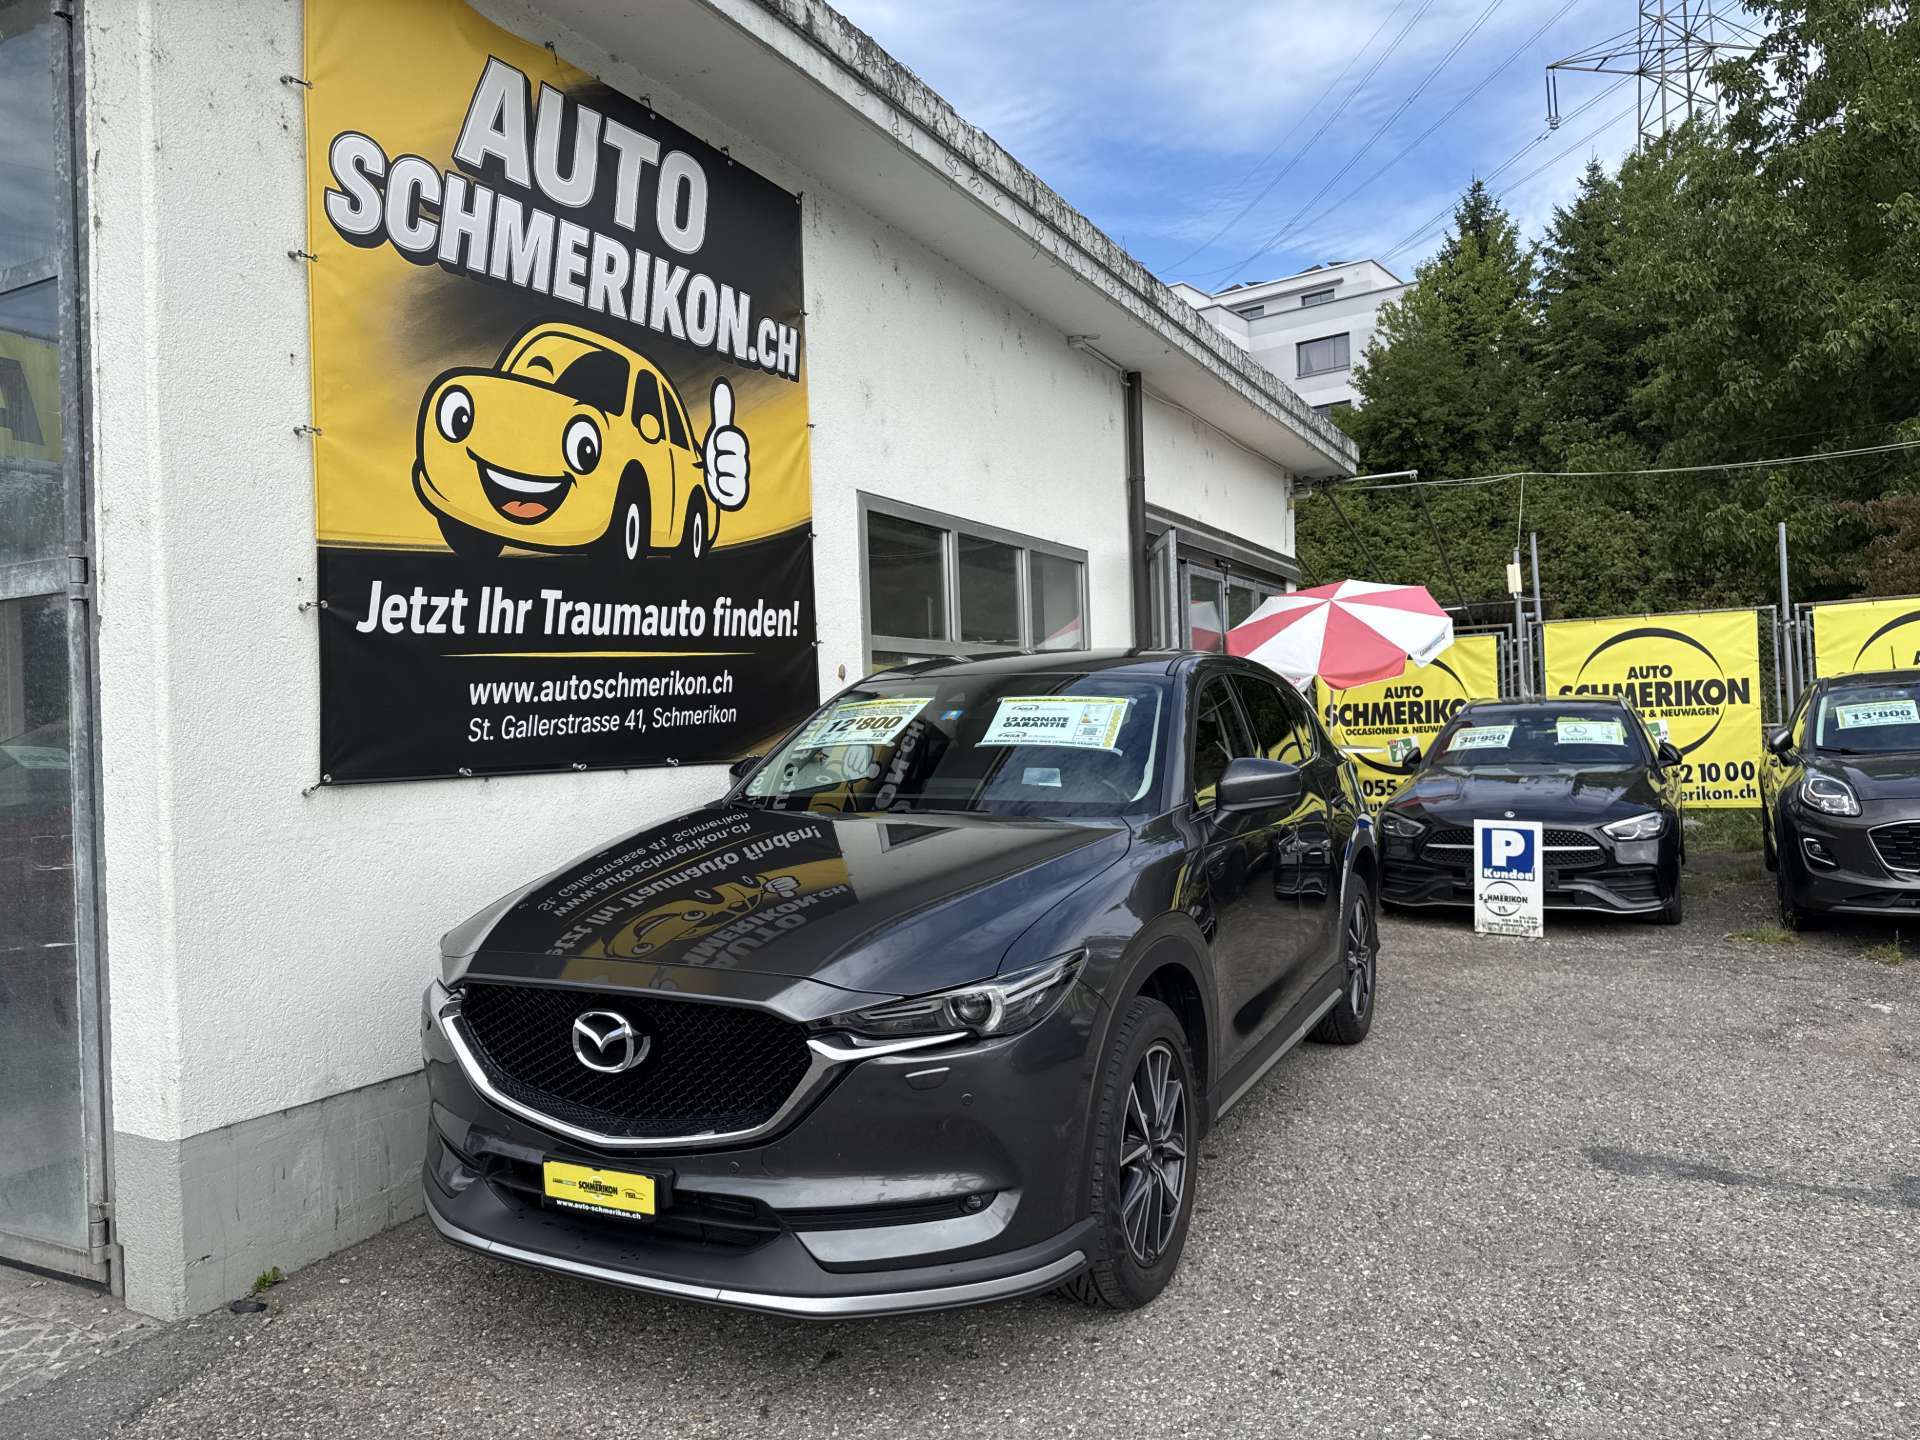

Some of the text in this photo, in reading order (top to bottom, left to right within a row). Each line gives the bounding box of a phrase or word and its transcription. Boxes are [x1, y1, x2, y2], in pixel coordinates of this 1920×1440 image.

[454, 55, 708, 254] AUTO
[325, 131, 799, 379] SCHMERIKON.CH
[356, 580, 800, 638] Jetzt Ihr Traumauto finden!
[1627, 665, 1672, 680] AUTO
[469, 670, 733, 705] www.autoschmerikon.ch
[1384, 685, 1424, 699] AUTO
[1649, 709, 1657, 717] &
[1660, 707, 1720, 717] NEUWAGEN
[1852, 710, 1911, 720] 13'800
[468, 705, 737, 743] St. Gallerstrasse 41, Schmerikon
[828, 716, 903, 733] 12'800
[1345, 727, 1399, 736] OCCASIONEN
[1698, 763, 1720, 783] 10
[1725, 761, 1755, 781] 00
[1491, 830, 1525, 867] P
[1484, 868, 1534, 880] Kunden
[1479, 893, 1528, 904] SHMERIKON
[579, 1180, 618, 1195] SCHMERIKON
[556, 1200, 641, 1219] www.auto-schmerikon.ch
